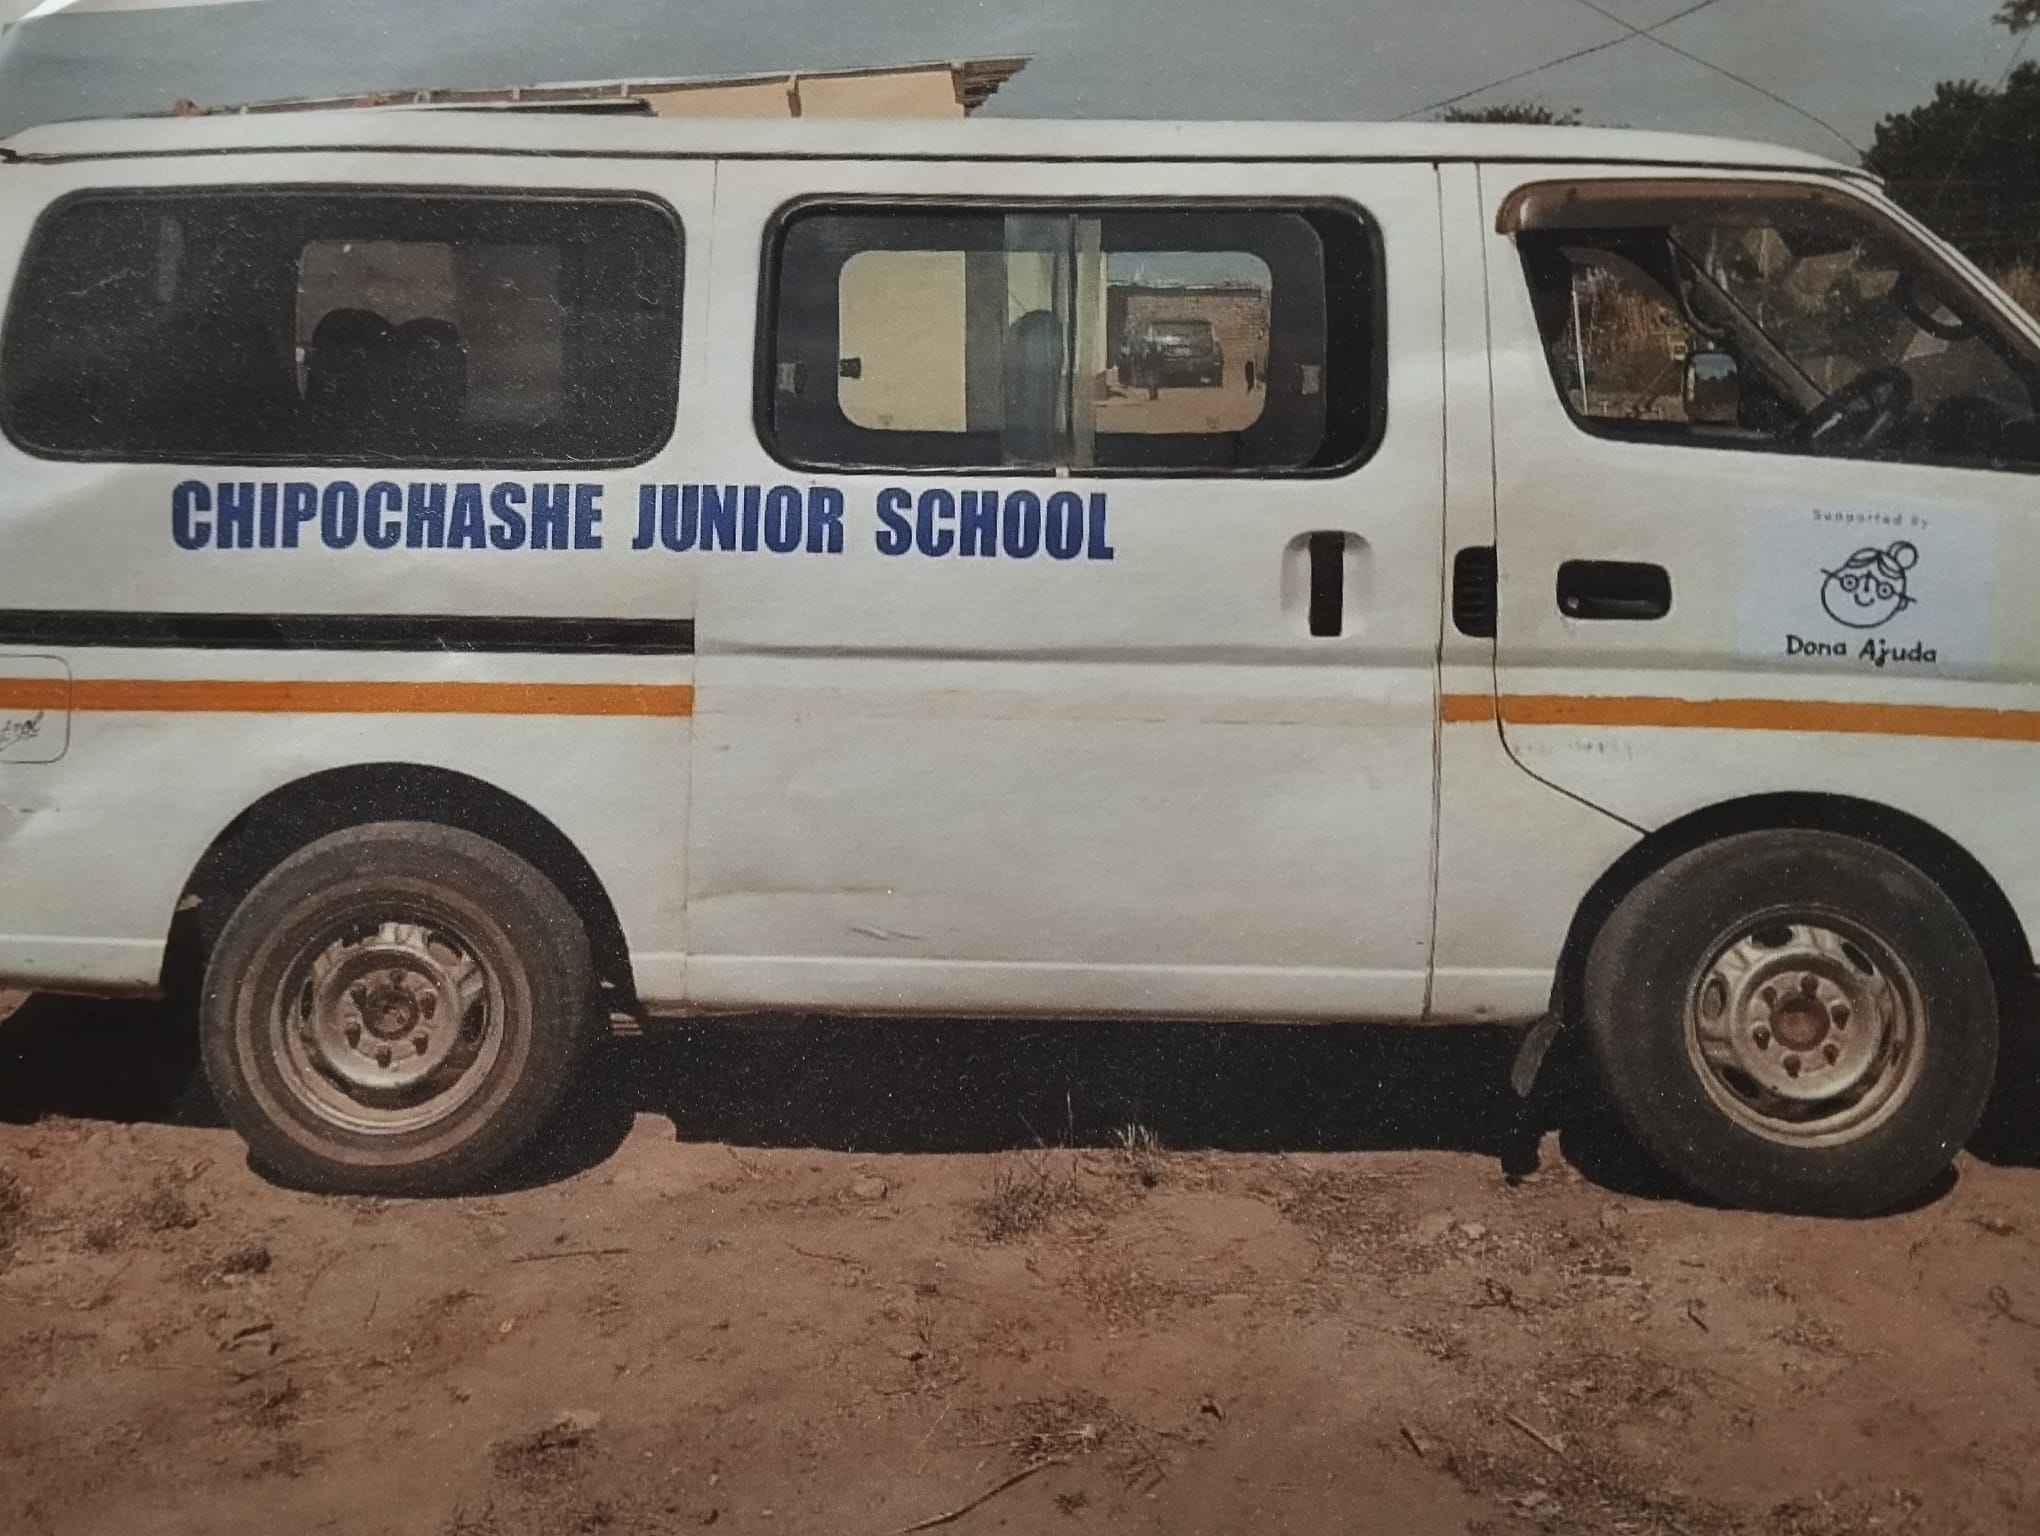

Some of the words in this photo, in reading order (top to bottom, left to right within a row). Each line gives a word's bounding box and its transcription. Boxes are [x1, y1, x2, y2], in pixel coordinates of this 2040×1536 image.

[171, 479, 604, 551] CHIPOCHASHE
[632, 483, 844, 554] JUNIOR
[875, 486, 1115, 560] SCHOOL
[1785, 633, 1848, 657] Dona
[1858, 637, 1937, 668] Ajuda
